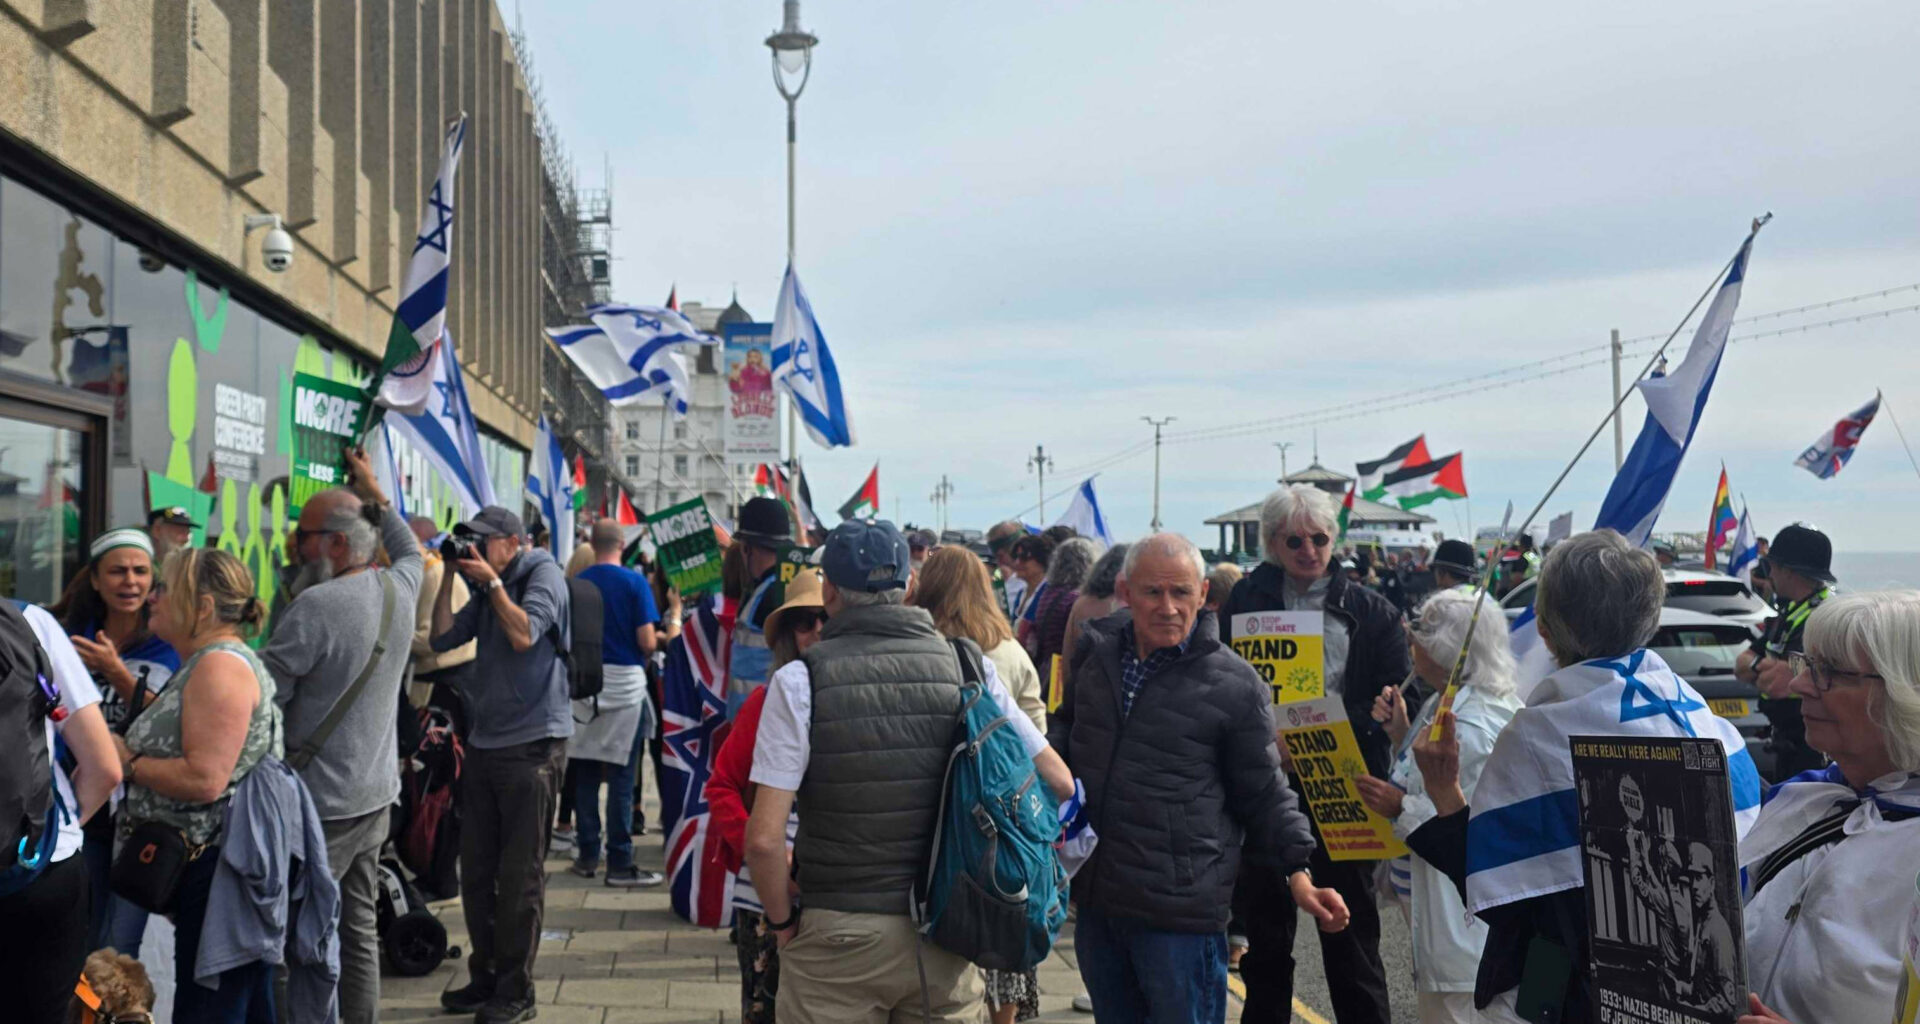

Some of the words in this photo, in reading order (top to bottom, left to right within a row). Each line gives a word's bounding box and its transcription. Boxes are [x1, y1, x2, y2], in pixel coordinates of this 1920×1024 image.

[295, 386, 362, 437] MORE
[308, 462, 335, 483] LESS
[651, 505, 710, 546] MORE
[681, 553, 707, 570] LESS
[1275, 624, 1296, 633] HATE
[1233, 639, 1298, 660] STAND
[1285, 729, 1338, 755] STAND
[1574, 743, 1588, 757] ARE
[1588, 744, 1599, 757] WE
[1599, 744, 1626, 759] REALLY
[1628, 745, 1649, 760] HERE
[1650, 746, 1682, 761] AGAIN?
[1701, 744, 1716, 755] OUR
[1295, 759, 1315, 779] UP
[1314, 756, 1335, 777] TO
[1701, 758, 1721, 769] FIGHT
[1304, 778, 1350, 801] RACIST
[1313, 801, 1368, 824] GREENS
[1599, 988, 1622, 1010] 1933:
[1623, 995, 1650, 1019] NAZIS
[1650, 1006, 1682, 1024] BEGAN
[1600, 1006, 1612, 1024] OF
